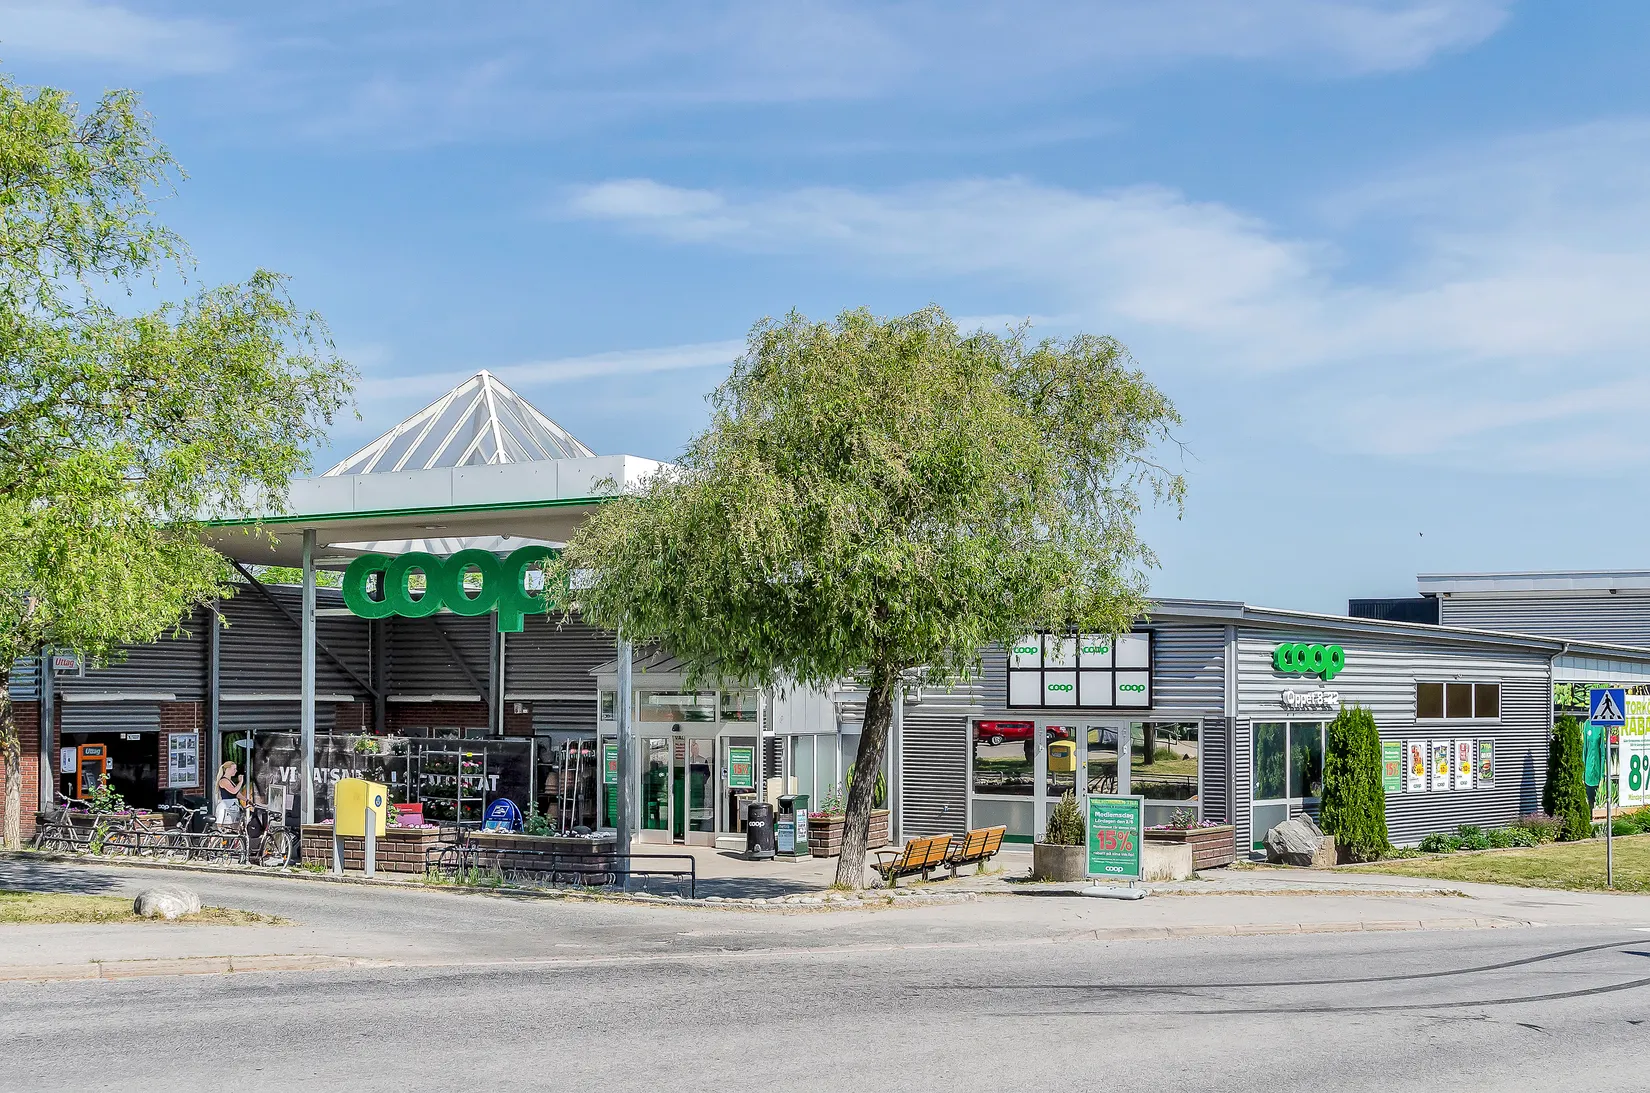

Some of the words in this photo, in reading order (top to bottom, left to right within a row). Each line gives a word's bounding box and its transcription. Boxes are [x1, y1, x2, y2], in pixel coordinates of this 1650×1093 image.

[342, 546, 566, 632] coop
[1013, 646, 1038, 655] coop
[55, 657, 75, 668] Uttag
[1275, 643, 1345, 681] coop
[1048, 684, 1073, 692] coop
[1119, 684, 1145, 693] coop
[1625, 699, 1650, 715] TORK
[279, 766, 297, 782] VI
[1094, 811, 1134, 820] Medlemsdag
[749, 820, 765, 828] coop
[1097, 829, 1133, 851] 15%
